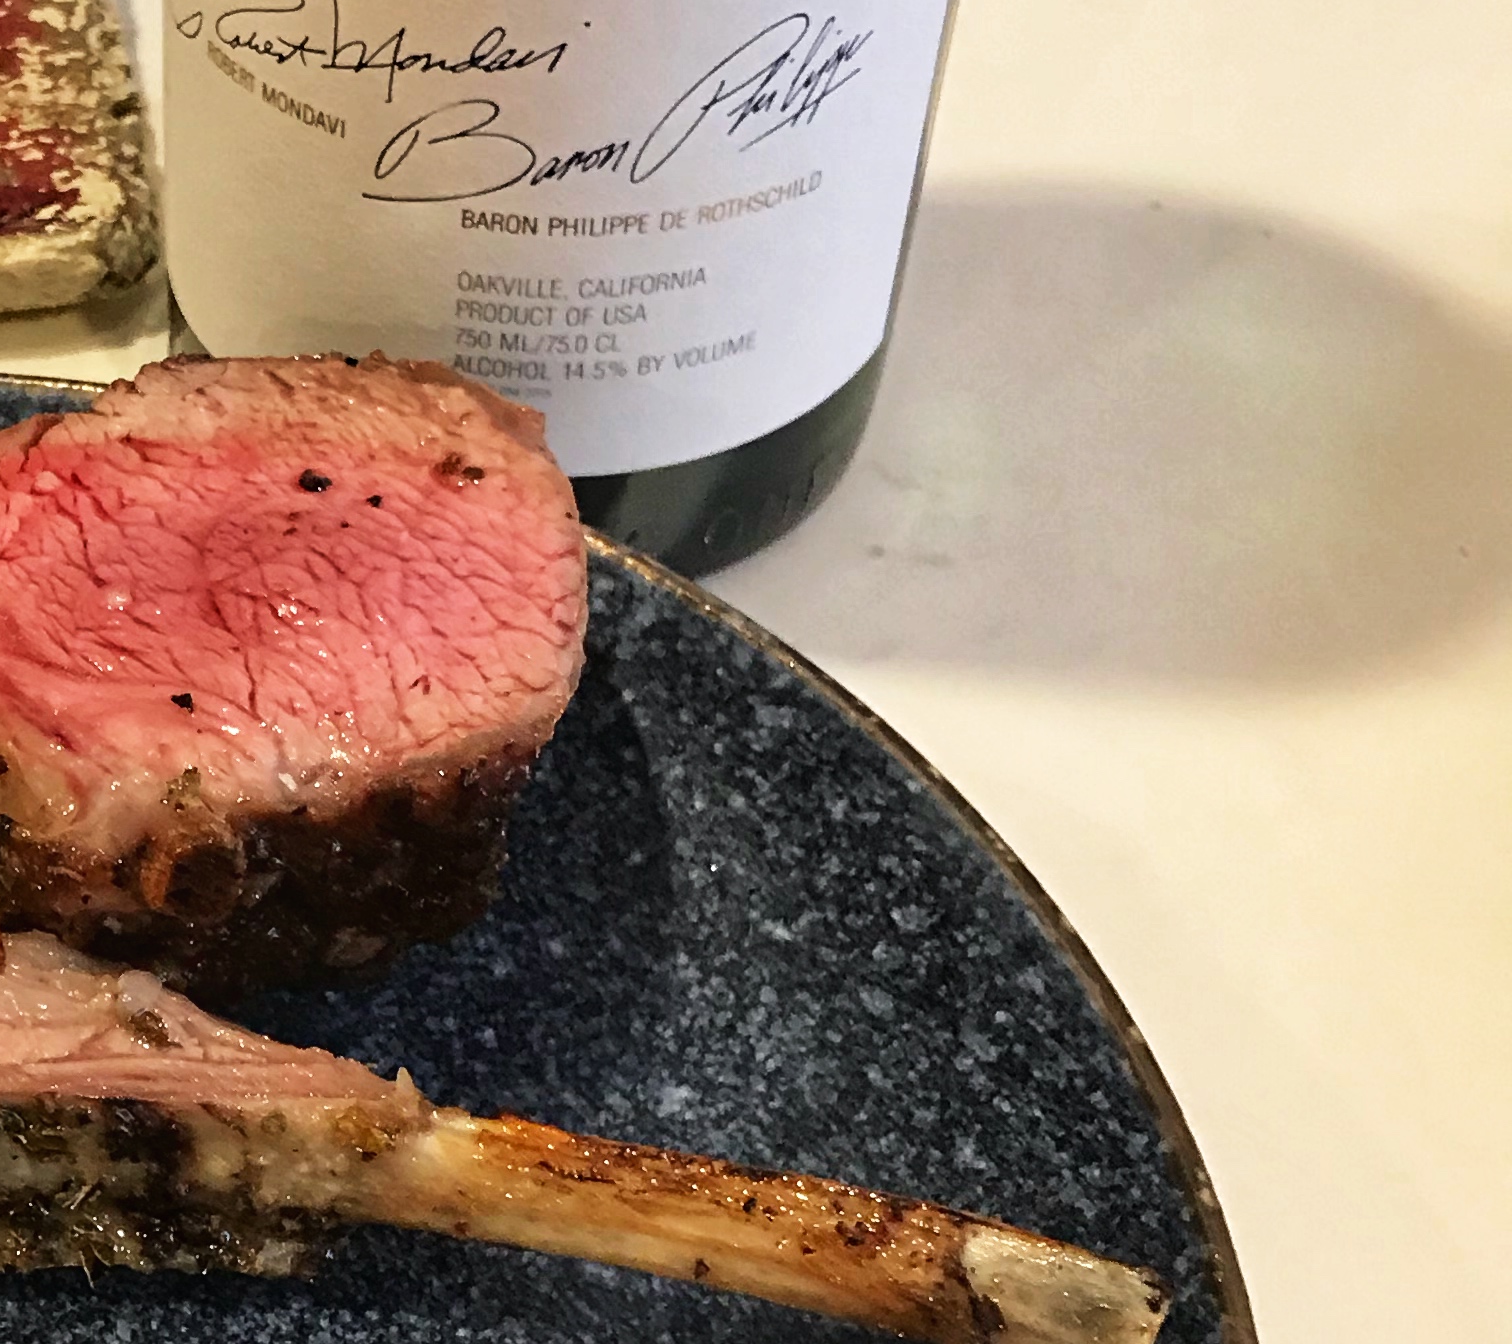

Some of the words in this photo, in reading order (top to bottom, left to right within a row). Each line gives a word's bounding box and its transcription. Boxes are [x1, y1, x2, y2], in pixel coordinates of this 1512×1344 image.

[261, 81, 347, 140] MONDAVI
[461, 208, 539, 237] BARON
[547, 213, 648, 238] PHILIPPE
[659, 211, 688, 233] DE
[696, 169, 824, 226] ROTHSCHILD
[577, 266, 708, 300] CALIFORNIA
[454, 298, 556, 327] PRODUCT
[565, 304, 595, 327] OF
[602, 302, 649, 326] USA
[452, 353, 551, 382] ALCOHOL
[637, 354, 667, 377] BY
[673, 328, 758, 370] VOLUME
[455, 326, 492, 349] 750
[594, 331, 623, 355] CL
